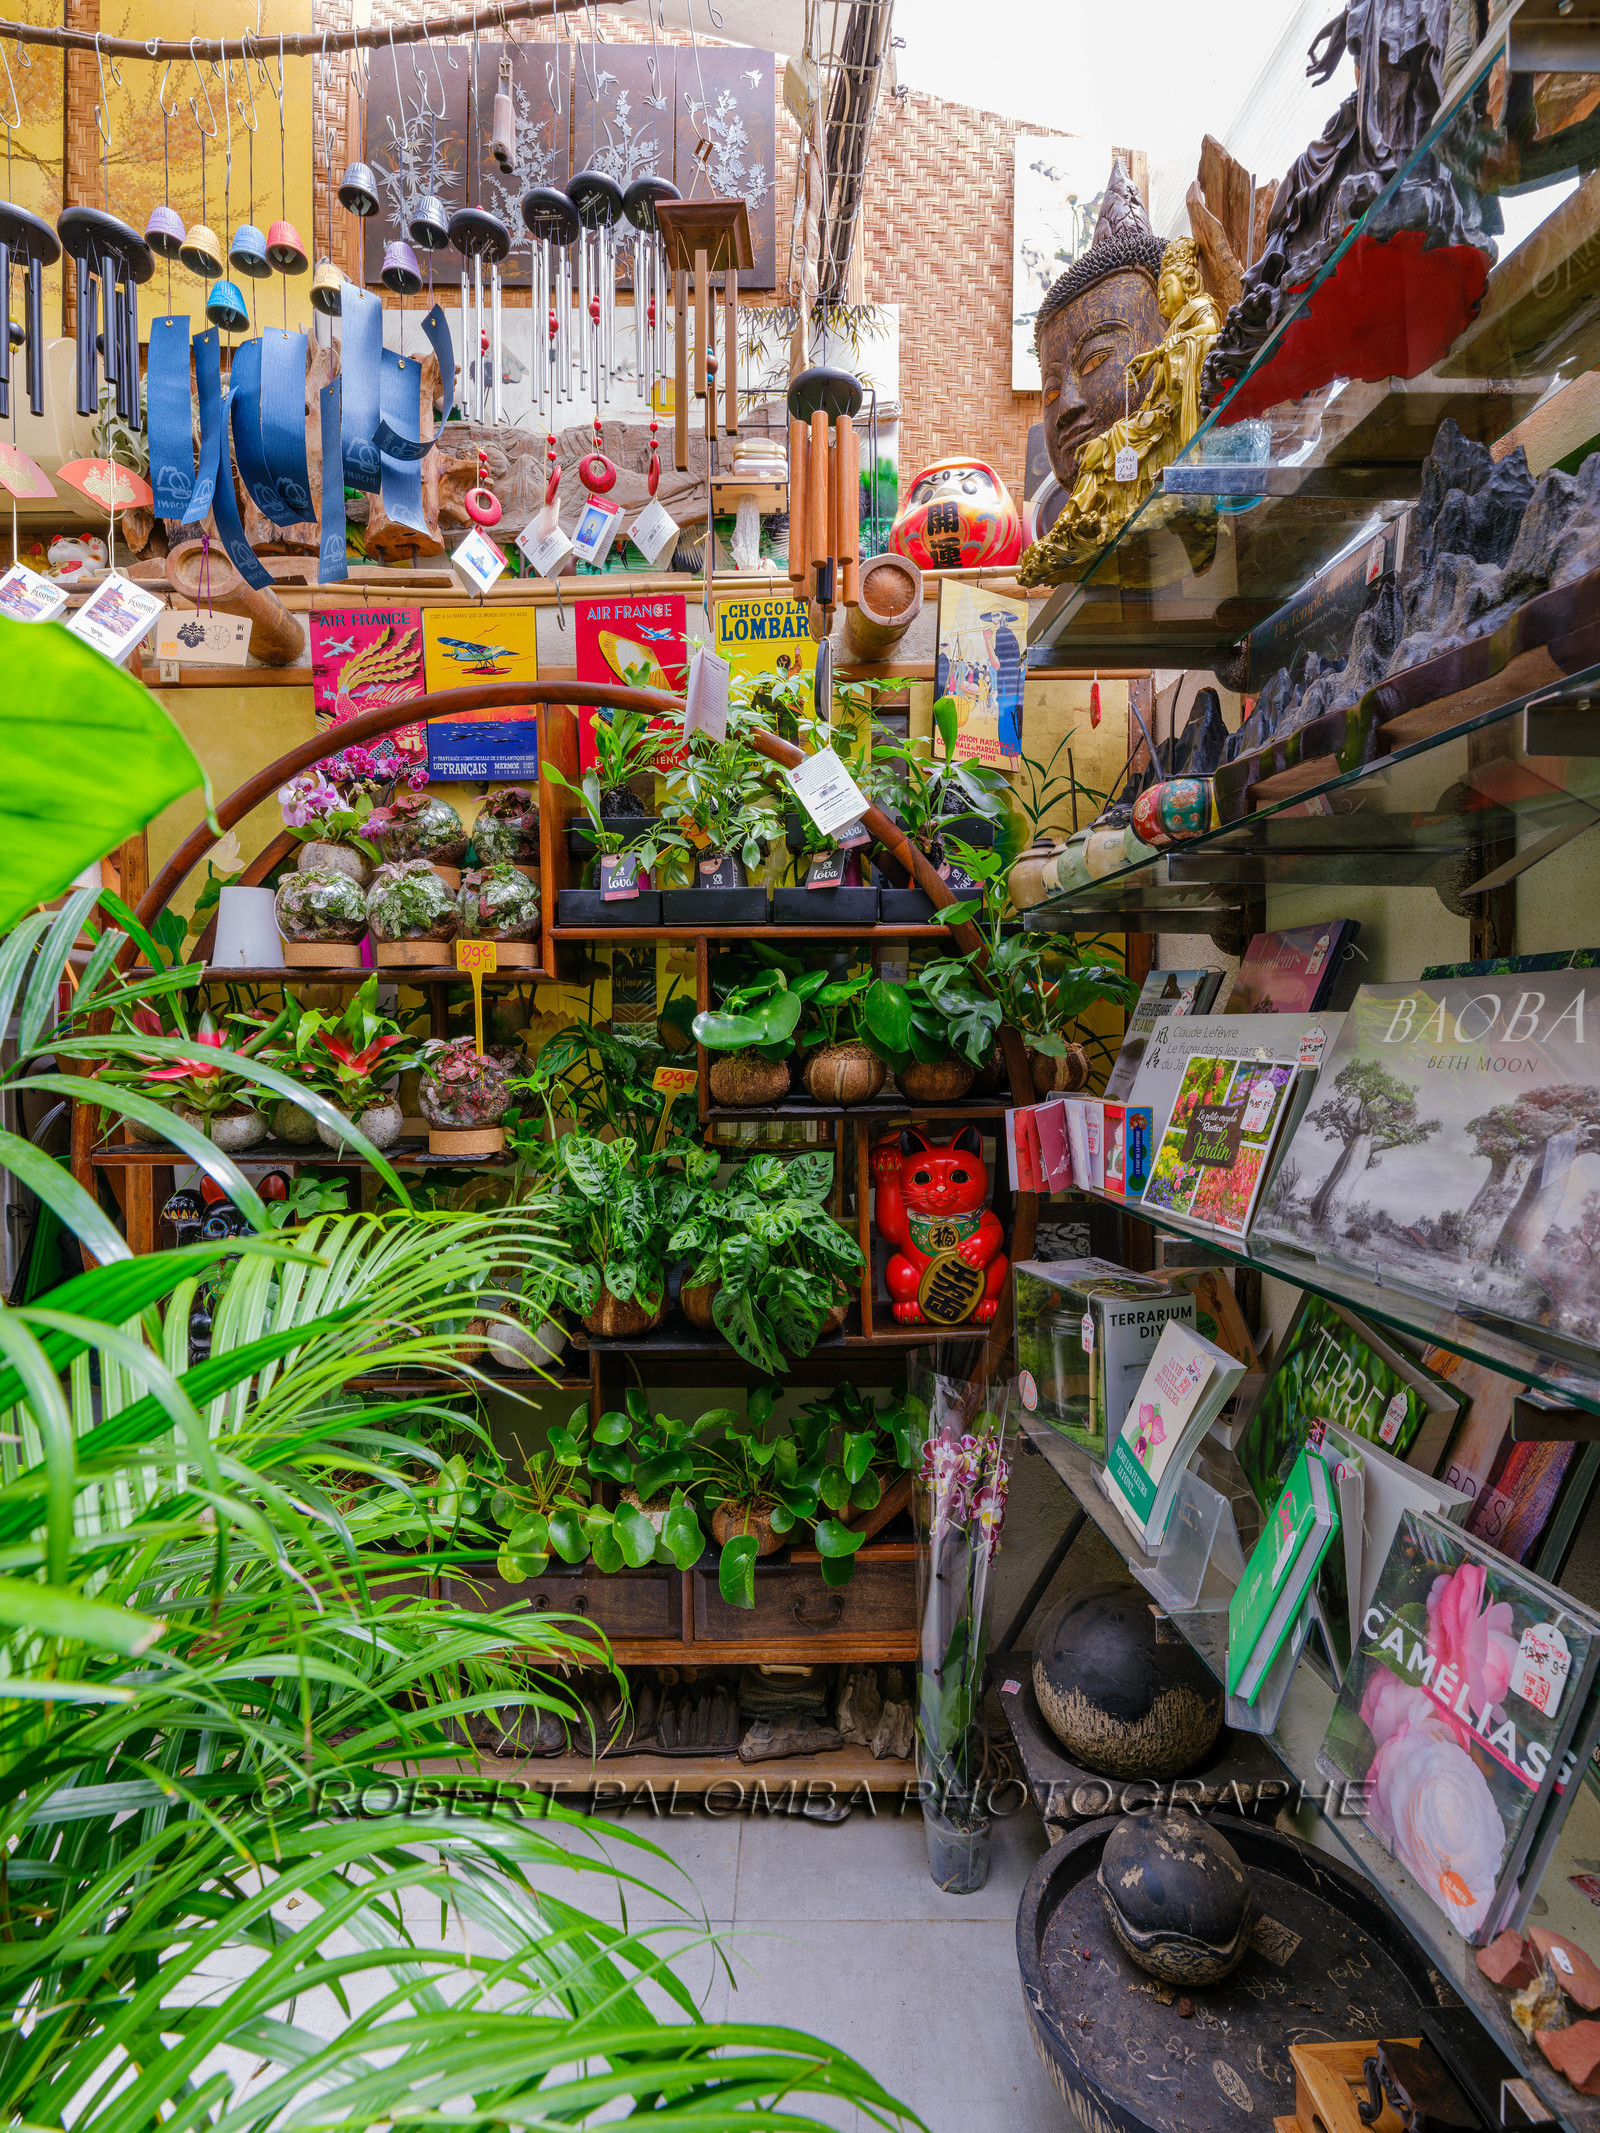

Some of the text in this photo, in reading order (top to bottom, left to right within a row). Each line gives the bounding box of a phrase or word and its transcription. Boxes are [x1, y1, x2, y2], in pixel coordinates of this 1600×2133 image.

[927, 500, 963, 570] 開運
[30, 588, 60, 605] PASSPORT
[127, 598, 157, 614] PASSPORT
[587, 603, 672, 621] AIR FRANCE
[1272, 618, 1289, 640] The
[1290, 590, 1326, 627] Temple
[320, 612, 411, 627] AIR FRANCE
[720, 615, 810, 641] LOMBAR
[936, 738, 971, 751] CONIALE
[443, 763, 487, 776] FRANÇAIS
[1173, 1026, 1239, 1039] Claude Lefèvre
[1167, 1042, 1180, 1054] Le
[1201, 1043, 1223, 1055] dans
[1225, 1043, 1238, 1055] les
[1161, 1059, 1173, 1070] du
[1427, 1056, 1539, 1073] BETH MOON
[657, 1071, 696, 1090] 29€
[1196, 1109, 1205, 1122] La
[1203, 1109, 1219, 1125] petite
[1109, 1305, 1193, 1327] TERRARIUM
[1139, 1324, 1164, 1339] DIY
[1310, 1318, 1319, 1336] LA
[1154, 1372, 1181, 1407] DES FLEURS
[1125, 1459, 1135, 1476] LES
[1131, 1470, 1149, 1498] FLEURS
[1378, 1600, 1398, 1619] THOMAS
[1403, 1621, 1424, 1639] OLIVIER
[1363, 1607, 1552, 1783] CAMÉLIAS
[1443, 1875, 1468, 1905] ULMER
